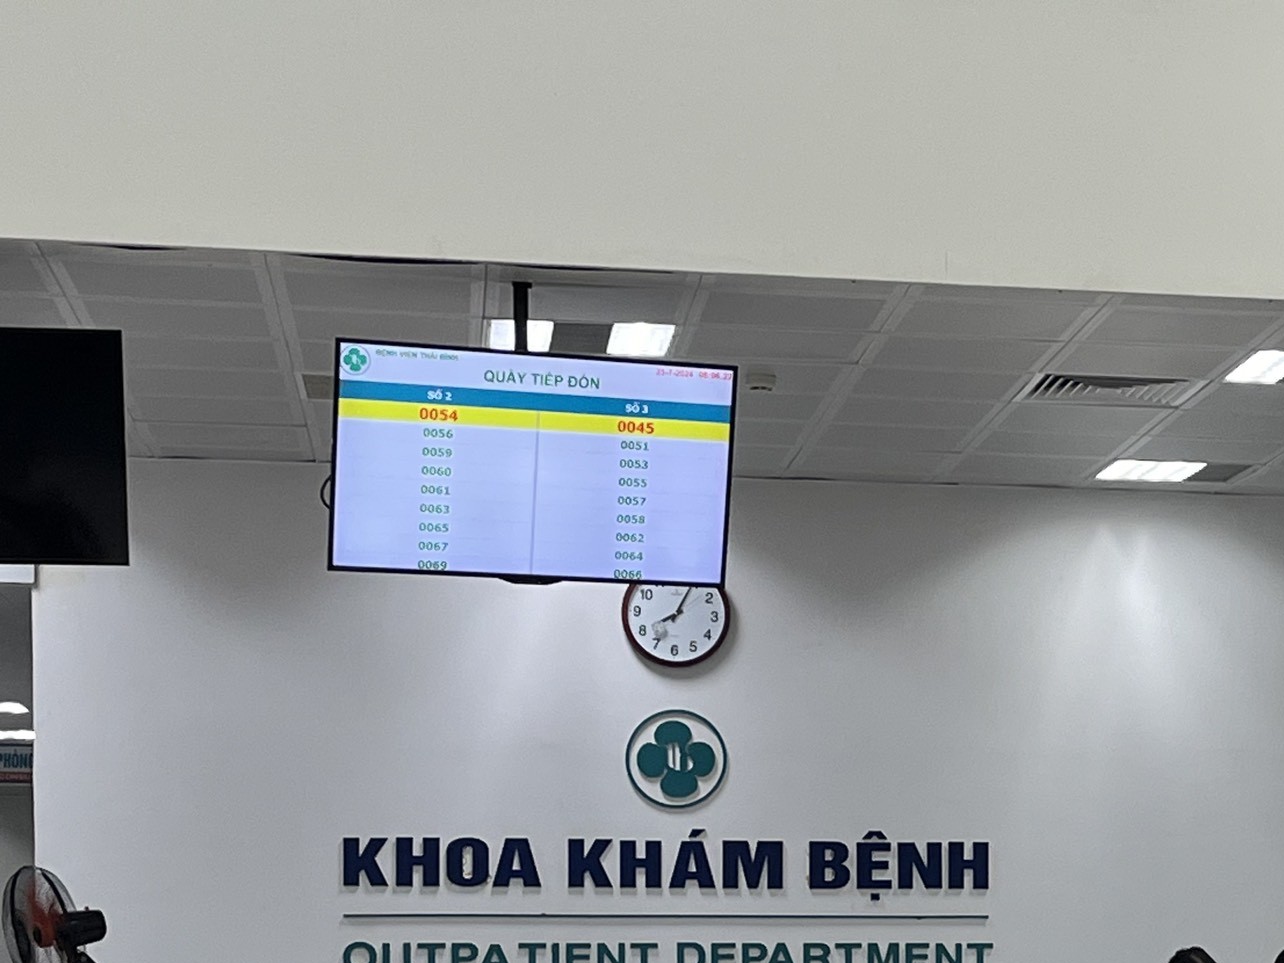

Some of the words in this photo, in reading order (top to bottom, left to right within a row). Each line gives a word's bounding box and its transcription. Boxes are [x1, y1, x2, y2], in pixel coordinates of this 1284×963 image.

[568, 374, 600, 390] ĐÓN
[445, 393, 453, 401] 2
[420, 408, 458, 422] 0054
[642, 406, 649, 414] 3
[423, 428, 454, 439] 0056
[618, 421, 655, 435] 0045
[620, 440, 649, 451] 0051
[422, 447, 453, 458] 0059
[619, 459, 649, 470] 0053
[421, 466, 452, 477] 0060
[618, 478, 648, 488] 0055
[420, 485, 450, 496] 0061
[617, 496, 646, 506] 0057
[419, 504, 450, 514] 0063
[616, 514, 646, 524] 0058
[419, 523, 449, 533] 0065
[615, 532, 645, 543] 0062
[418, 541, 449, 551] 0067
[614, 551, 644, 561] 0064
[417, 560, 447, 570] 0069
[613, 569, 643, 580] 0066
[640, 589, 653, 600] 10
[705, 592, 714, 604] 2
[633, 605, 641, 617] 9
[710, 611, 719, 622] 3
[639, 624, 647, 636] 8
[703, 629, 712, 640] 4
[652, 637, 661, 650] 7
[689, 640, 698, 652] 5
[670, 644, 679, 656] 6
[342, 836, 541, 888] KHOA
[567, 828, 784, 890] KHÁM
[808, 830, 989, 901] BỆNH
